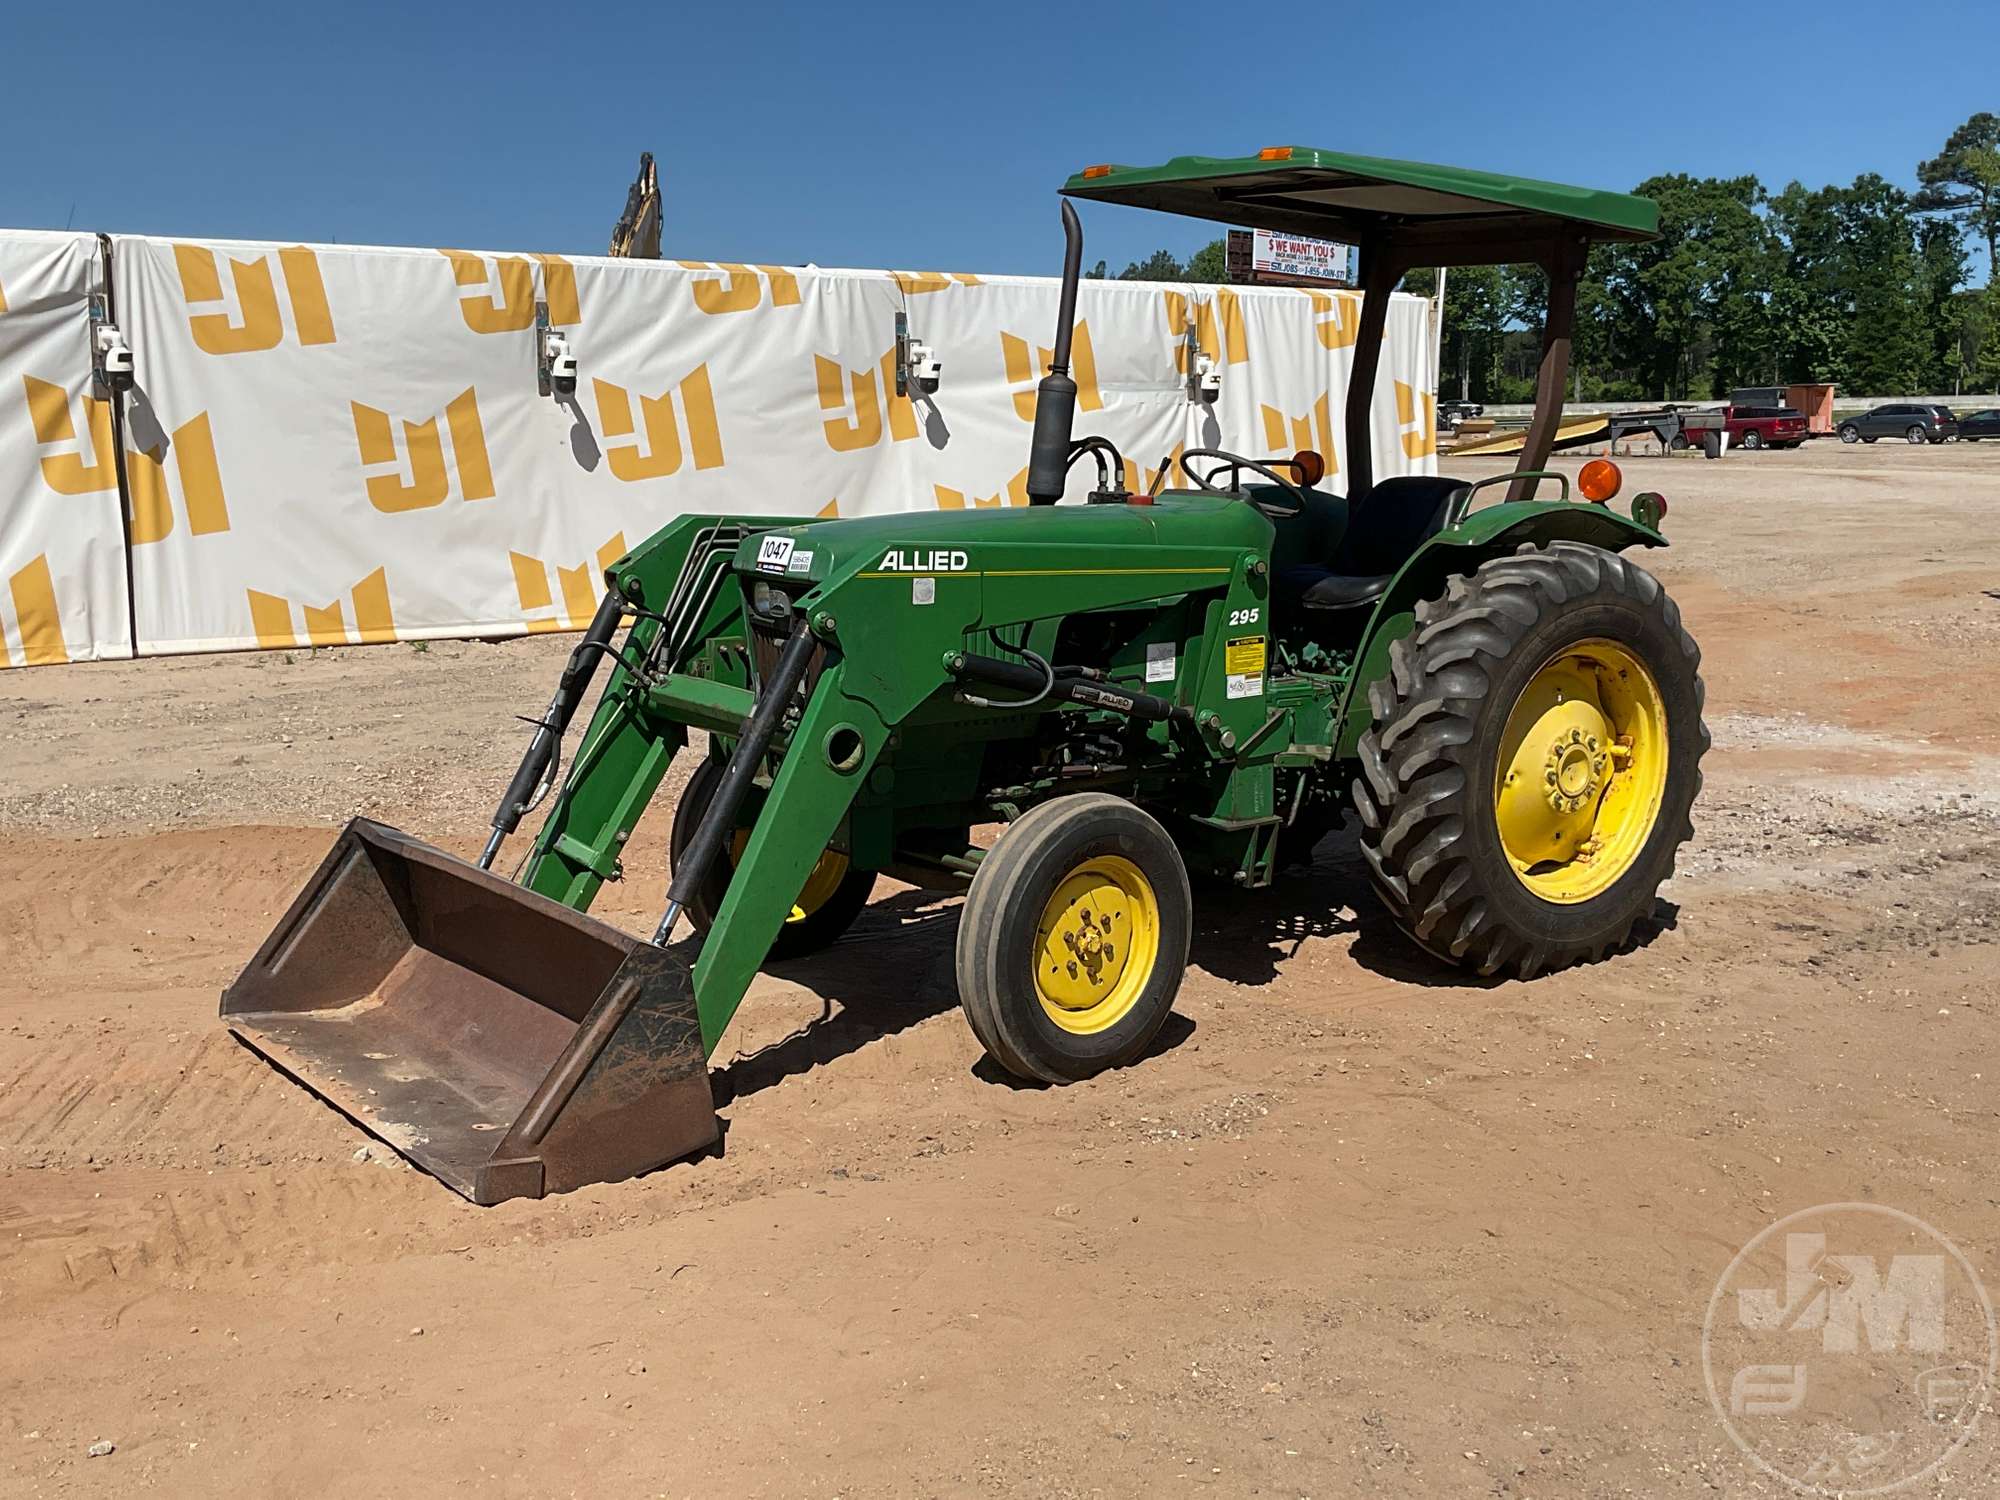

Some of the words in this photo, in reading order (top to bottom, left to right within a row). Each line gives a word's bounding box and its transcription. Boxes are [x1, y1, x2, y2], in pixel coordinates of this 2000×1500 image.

[1275, 240, 1288, 252] WE
[1289, 241, 1311, 255] WANT
[1313, 244, 1329, 257] YOU
[763, 541, 790, 560] 1047
[878, 550, 968, 571] ALLIED
[1229, 608, 1259, 626] 295
[1101, 694, 1130, 707] ALLIED
